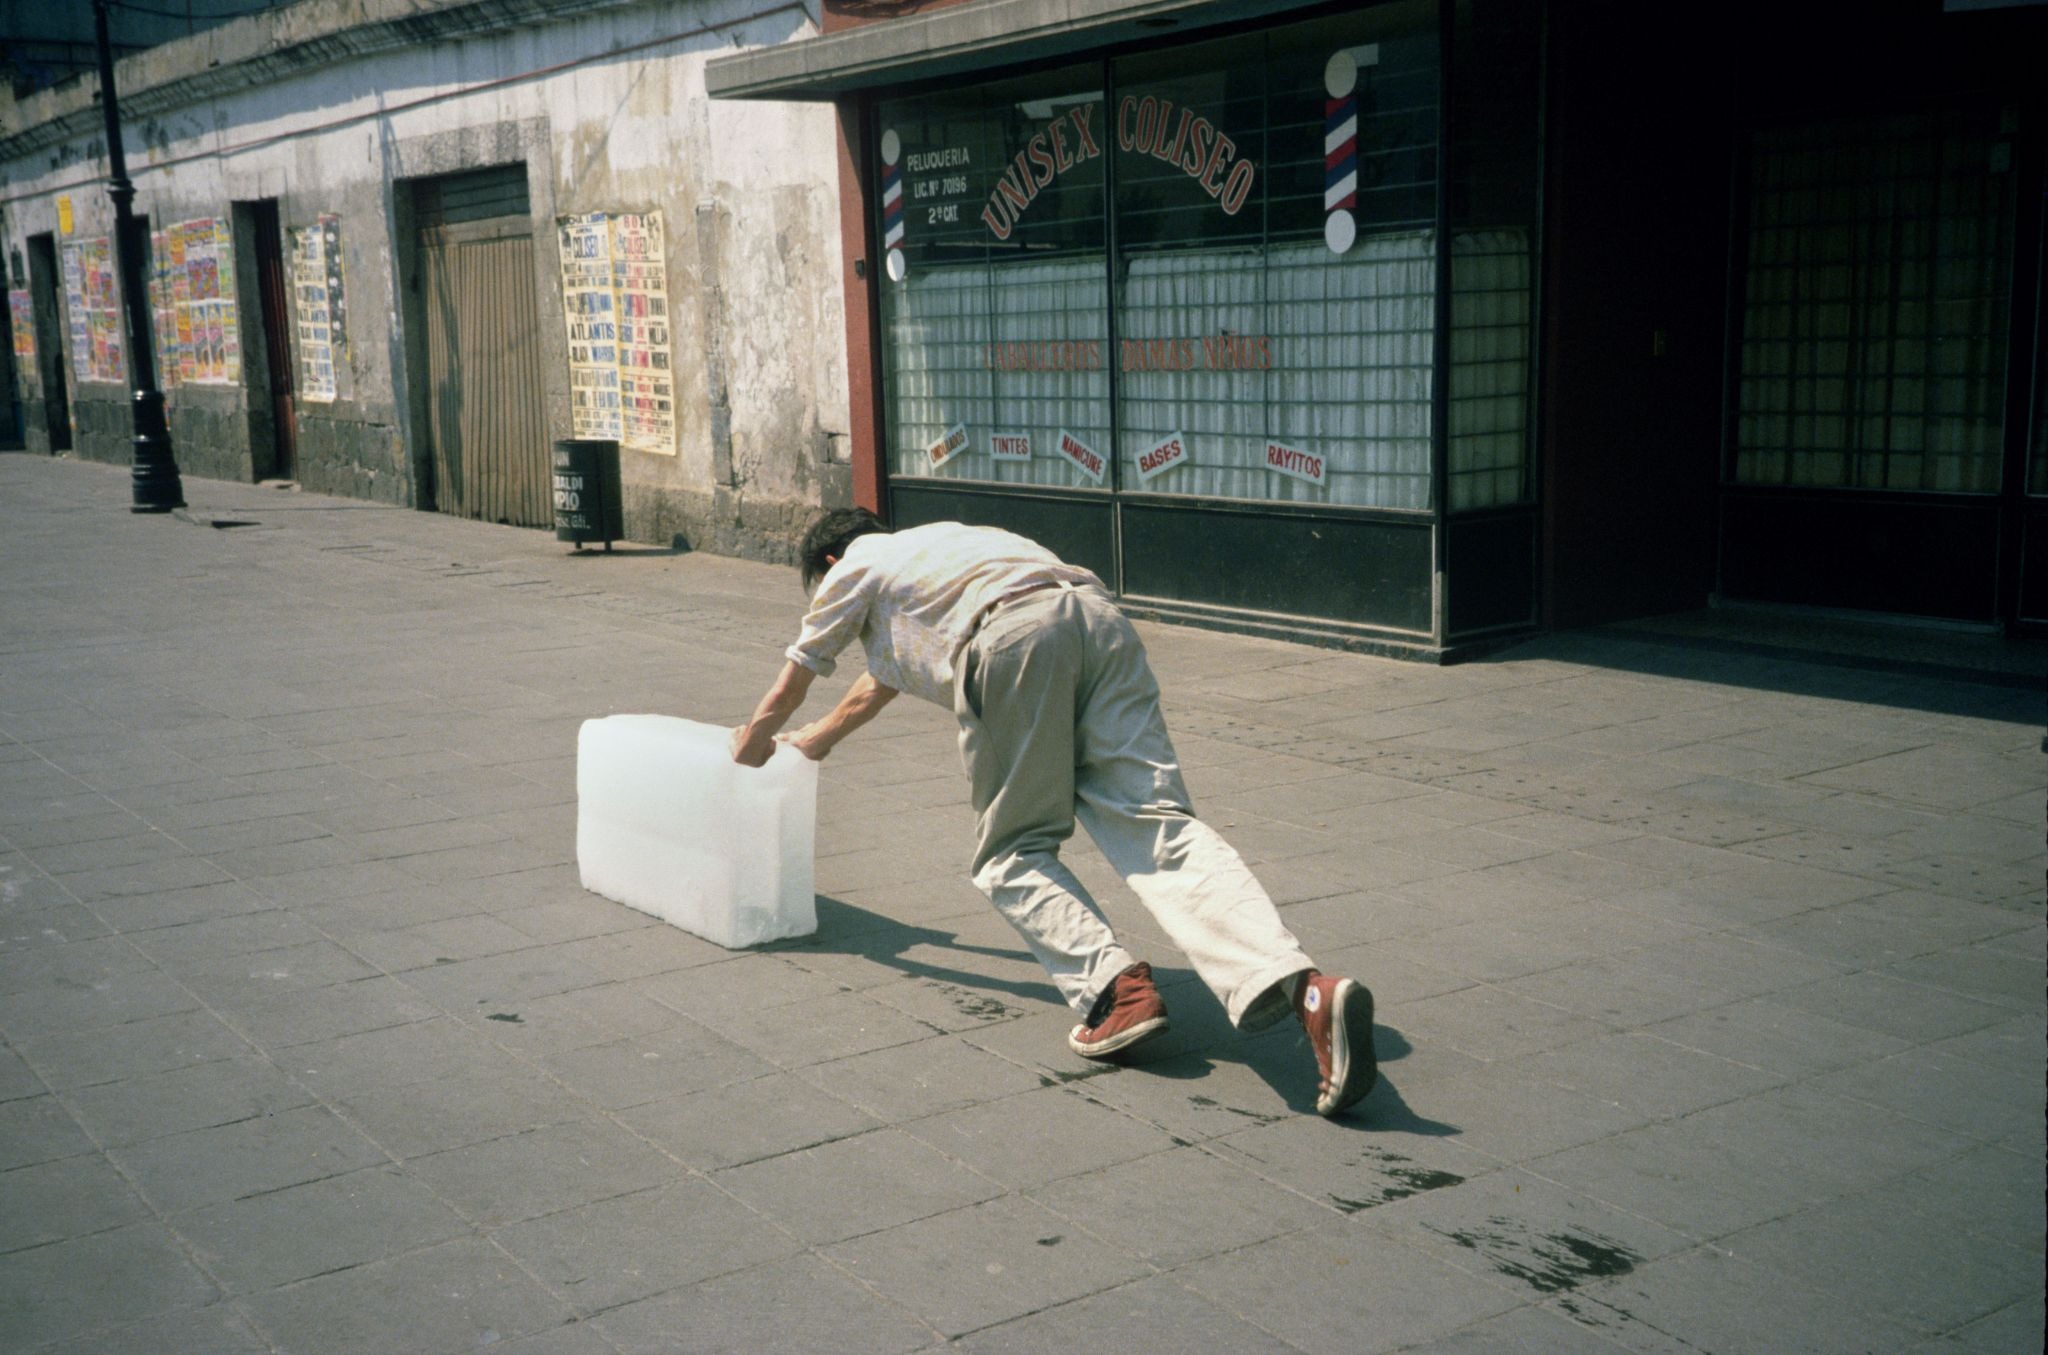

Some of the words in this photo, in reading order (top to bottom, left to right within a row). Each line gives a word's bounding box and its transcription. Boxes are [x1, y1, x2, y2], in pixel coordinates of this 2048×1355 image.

[907, 146, 970, 172] PELUQUERIA
[981, 103, 1100, 240] UNISEX
[1119, 95, 1254, 216] COLISEO
[570, 323, 616, 341] ATLANTIS
[1122, 337, 1194, 371] DAMAS
[991, 436, 1029, 455] TINTES
[1061, 434, 1103, 476] MANICURE
[1139, 439, 1182, 474] BASES
[1268, 445, 1322, 478] RAYITOS
